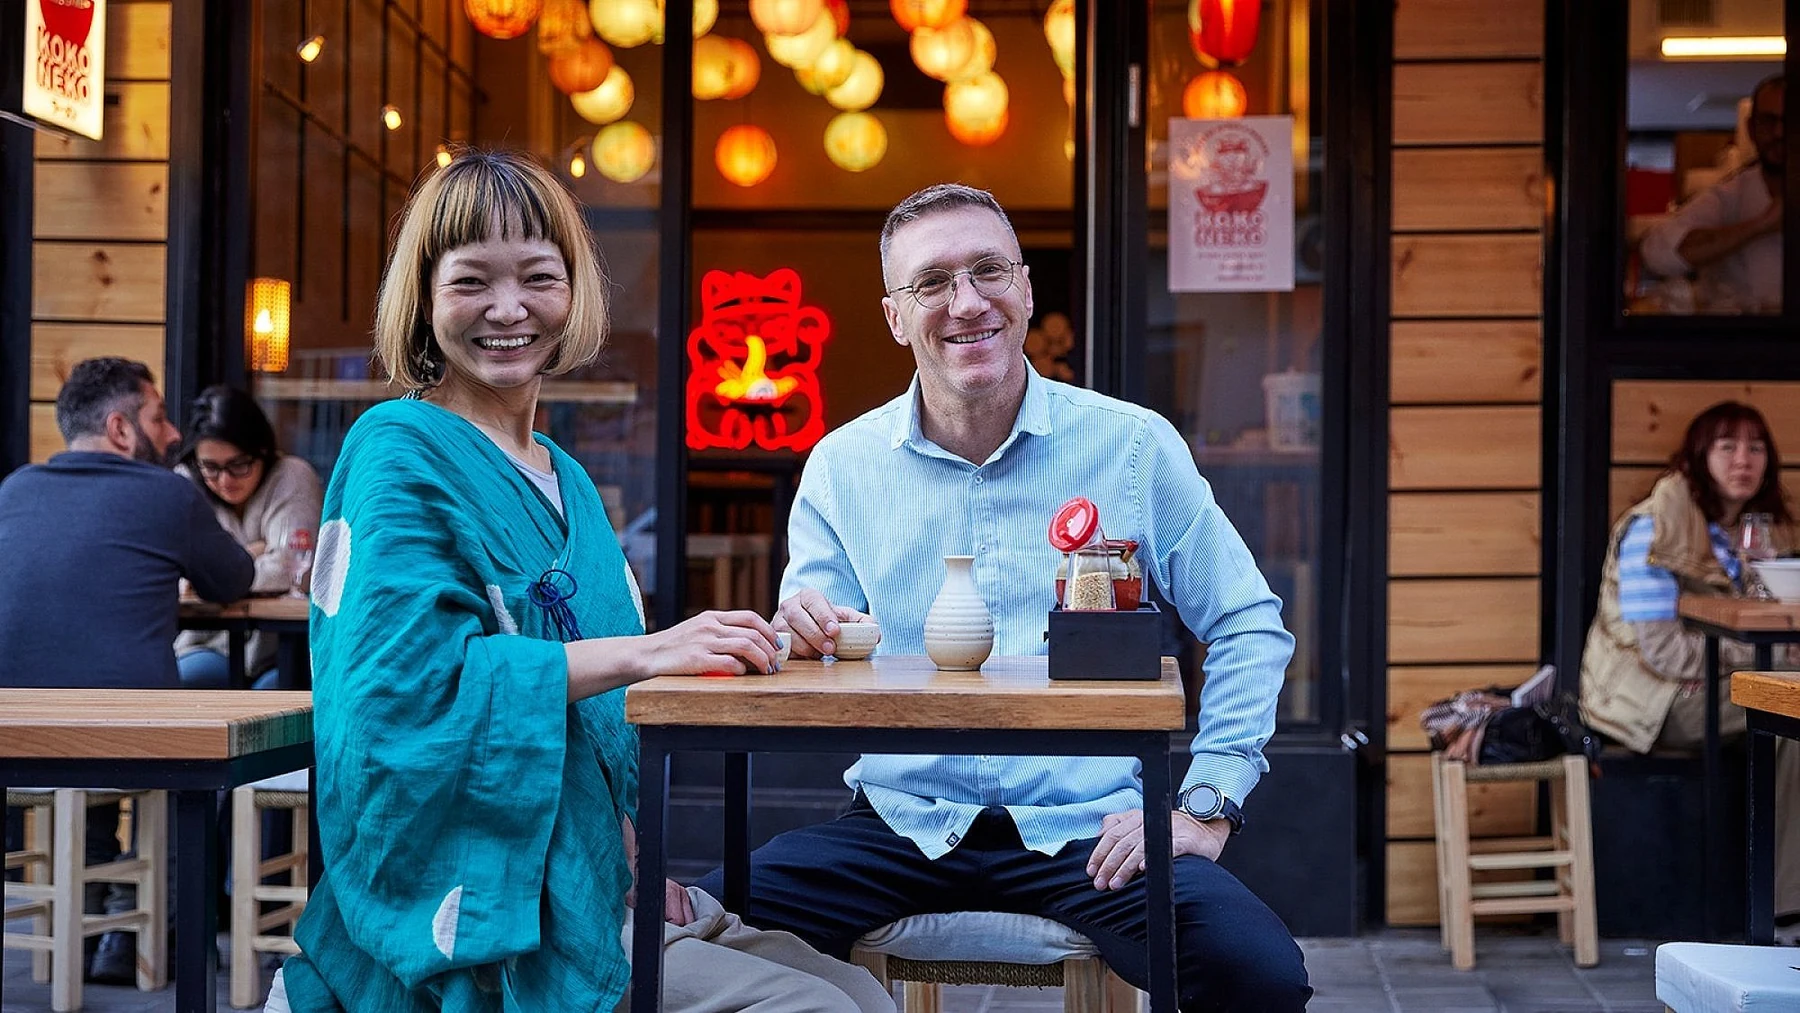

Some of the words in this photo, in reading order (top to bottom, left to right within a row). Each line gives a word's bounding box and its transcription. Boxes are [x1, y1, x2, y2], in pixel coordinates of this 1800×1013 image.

[37, 26, 90, 75] KOKO
[37, 56, 90, 104] NEKO
[1195, 211, 1267, 229] KOKO
[1195, 229, 1267, 247] NEKO
